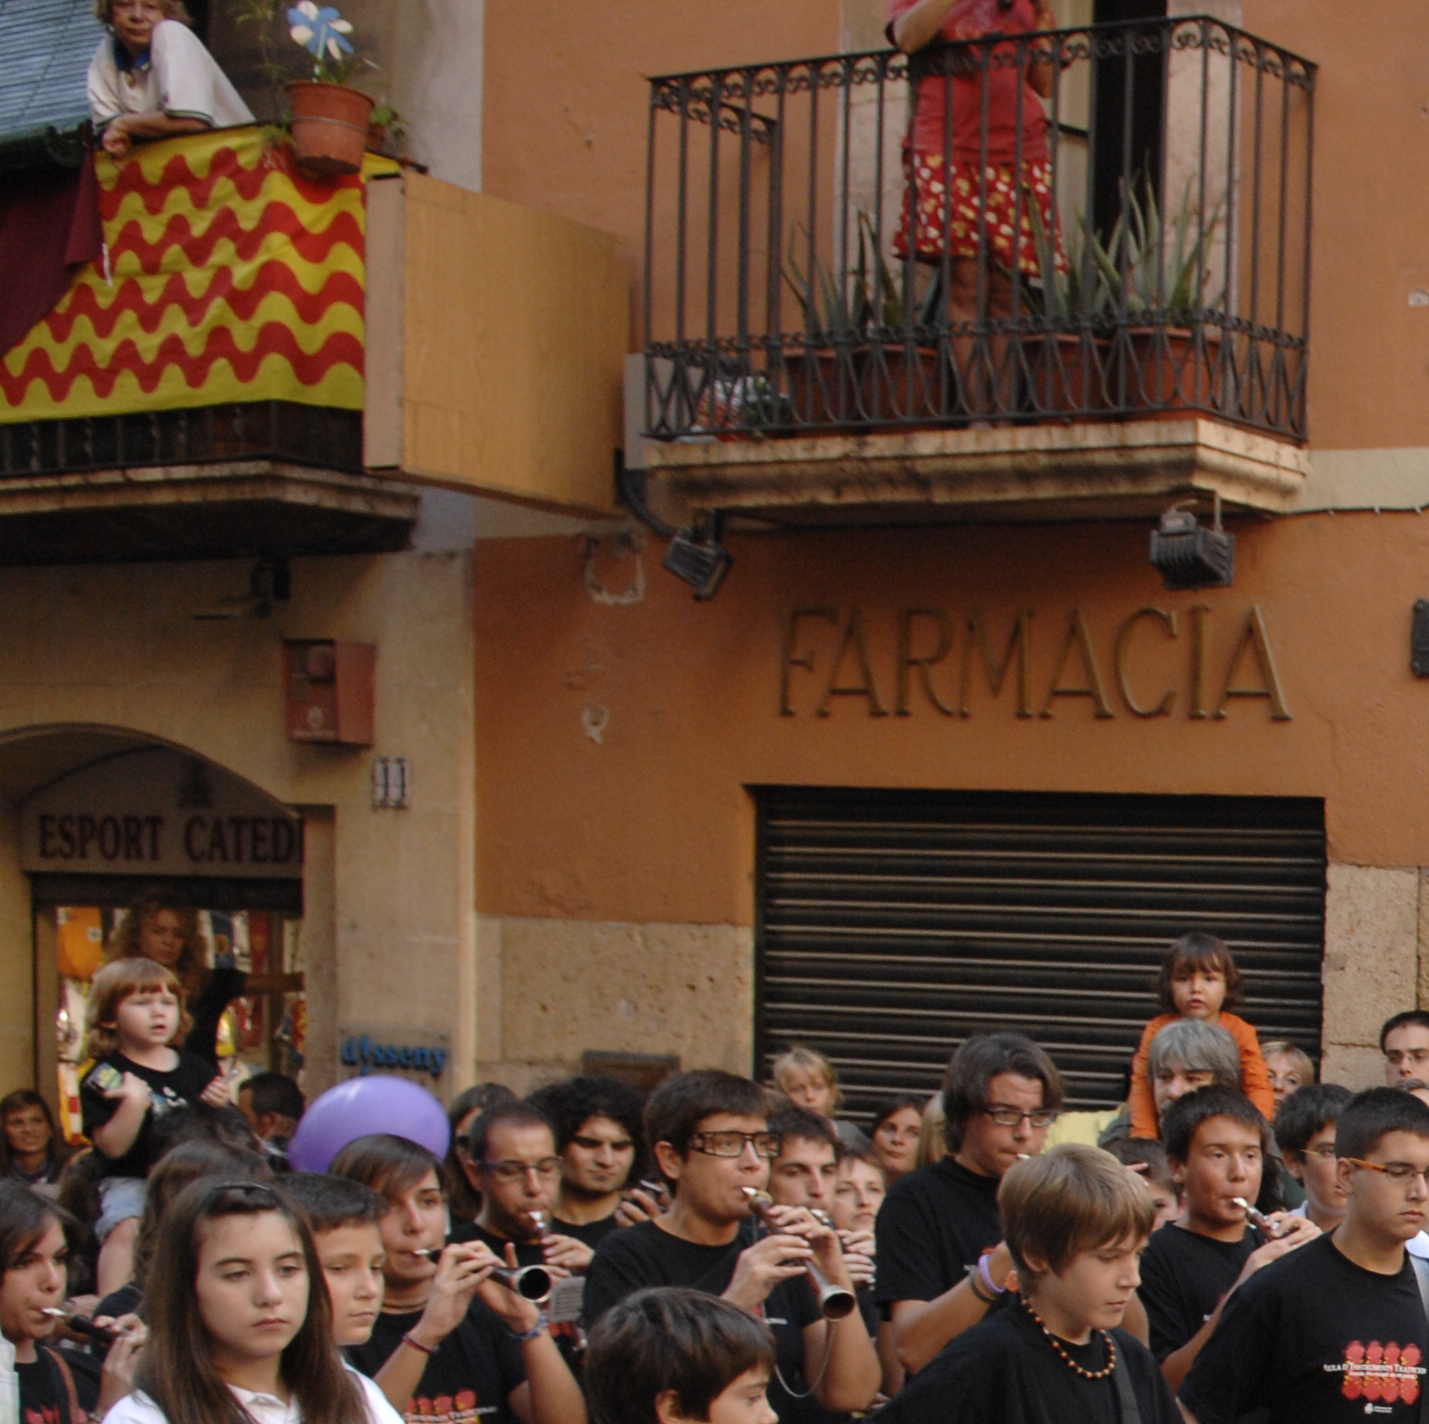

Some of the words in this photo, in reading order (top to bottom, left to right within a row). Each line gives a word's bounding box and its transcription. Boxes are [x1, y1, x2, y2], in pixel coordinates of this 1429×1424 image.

[778, 604, 1292, 720] FARMACIA
[39, 814, 164, 861] ESPORT
[184, 815, 304, 864] CATED
